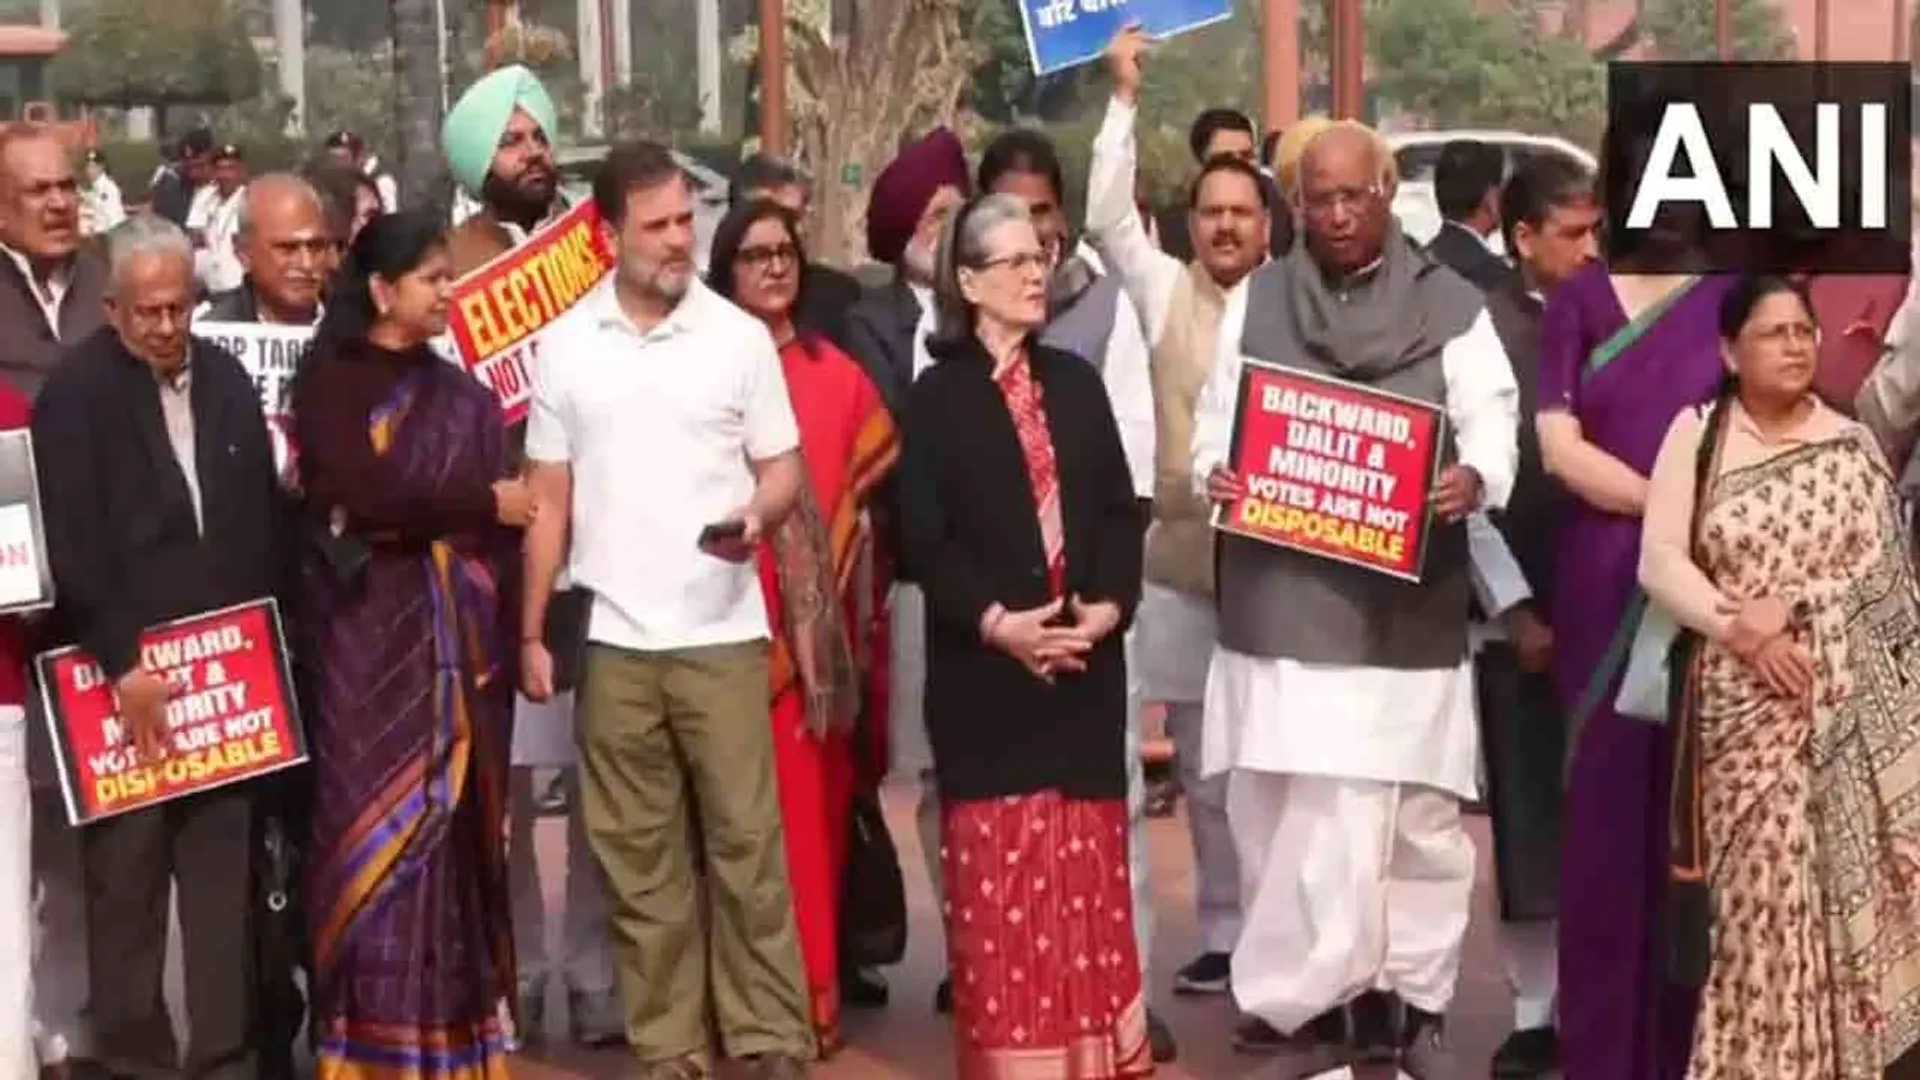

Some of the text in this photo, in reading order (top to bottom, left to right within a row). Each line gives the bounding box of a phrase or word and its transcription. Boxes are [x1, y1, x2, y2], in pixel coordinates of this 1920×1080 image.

[1287, 420, 1362, 463] DALIT
[1247, 474, 1409, 531] VOTES ARE NOT
[1269, 445, 1397, 503] MINORITY
[1241, 497, 1404, 561] DISPOSABLE
[102, 682, 246, 746] MORITY
[173, 721, 221, 751] ARE
[224, 706, 273, 739] NOT
